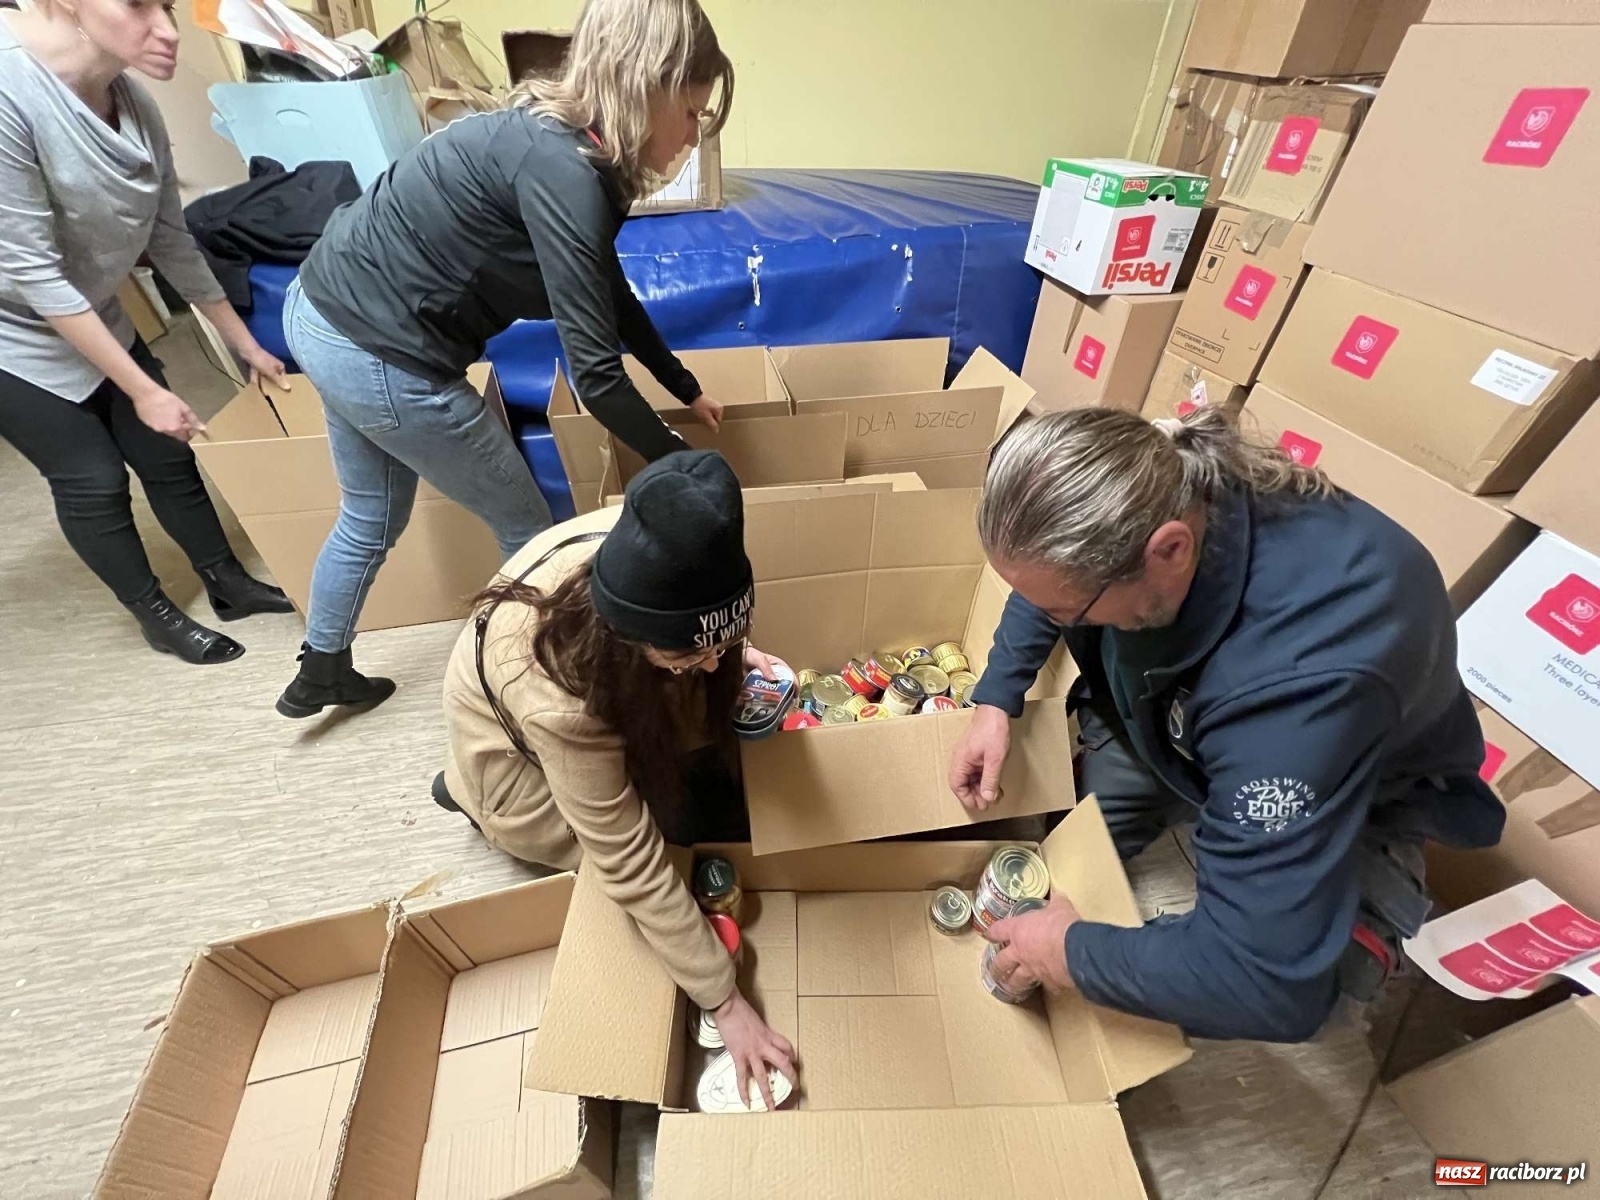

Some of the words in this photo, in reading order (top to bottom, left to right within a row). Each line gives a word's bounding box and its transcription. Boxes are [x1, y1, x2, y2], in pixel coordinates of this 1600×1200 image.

[1122, 178, 1149, 193] Persil
[1102, 262, 1171, 290] Persil
[856, 411, 896, 437] DLA
[915, 411, 977, 429] DZIECI
[694, 631, 716, 649] SIT
[720, 613, 748, 642] WITH
[700, 607, 728, 632] YOU
[1466, 666, 1487, 684] 2000
[1485, 681, 1513, 704] pieces
[1543, 662, 1574, 689] Three
